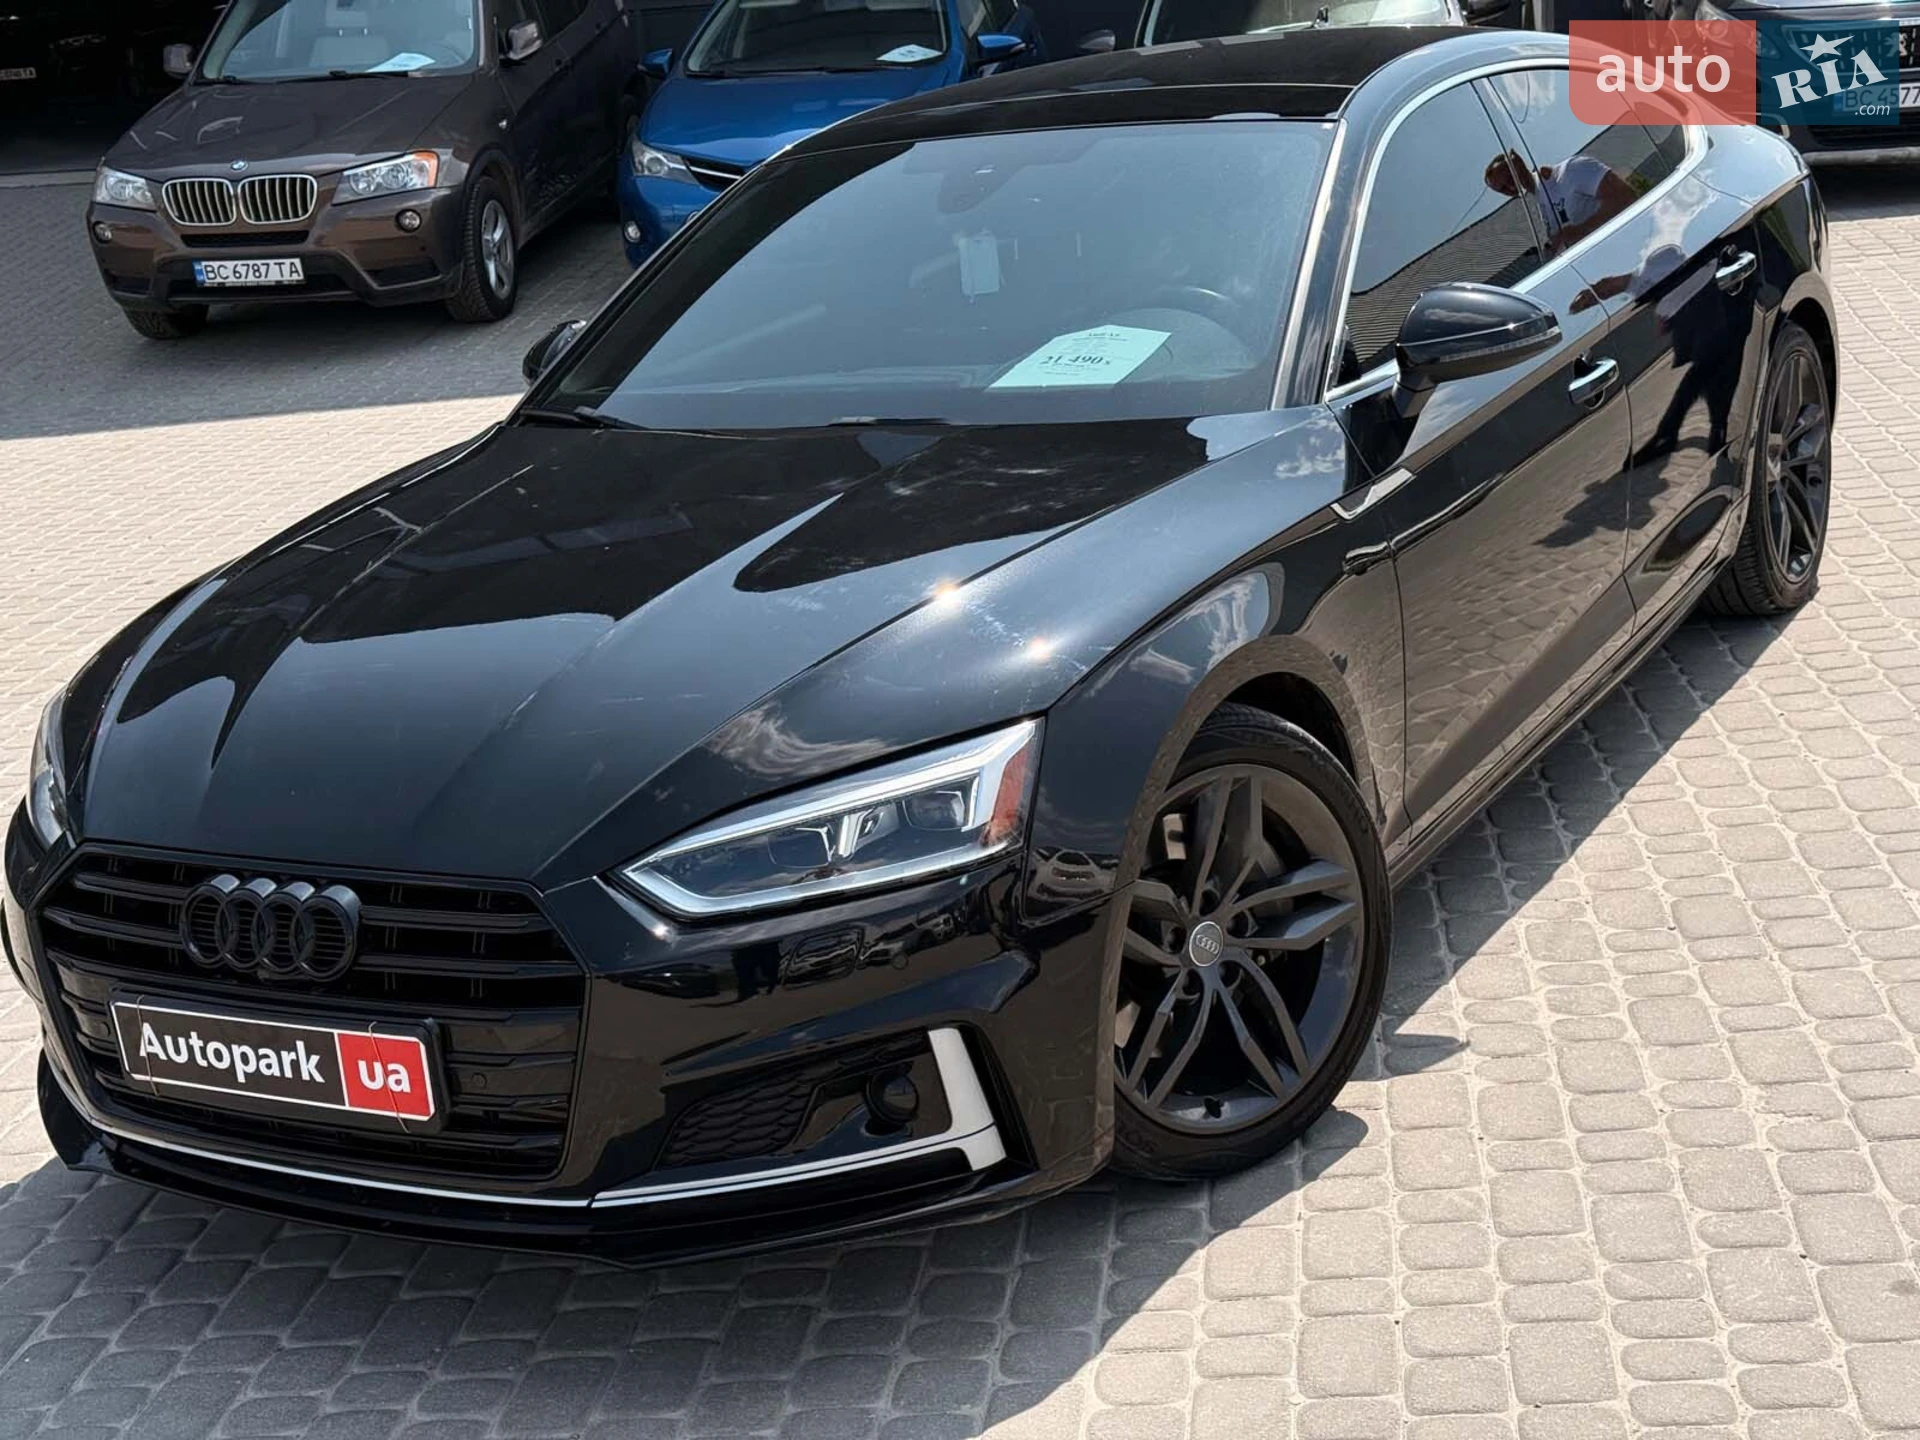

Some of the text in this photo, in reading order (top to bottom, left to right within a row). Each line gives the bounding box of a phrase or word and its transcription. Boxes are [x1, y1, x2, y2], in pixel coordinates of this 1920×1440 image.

[1844, 89, 1873, 108] BC
[203, 264, 230, 281] BC
[232, 262, 270, 280] 6787
[273, 261, 301, 278] TA
[139, 1022, 411, 1094] Autopark ua
